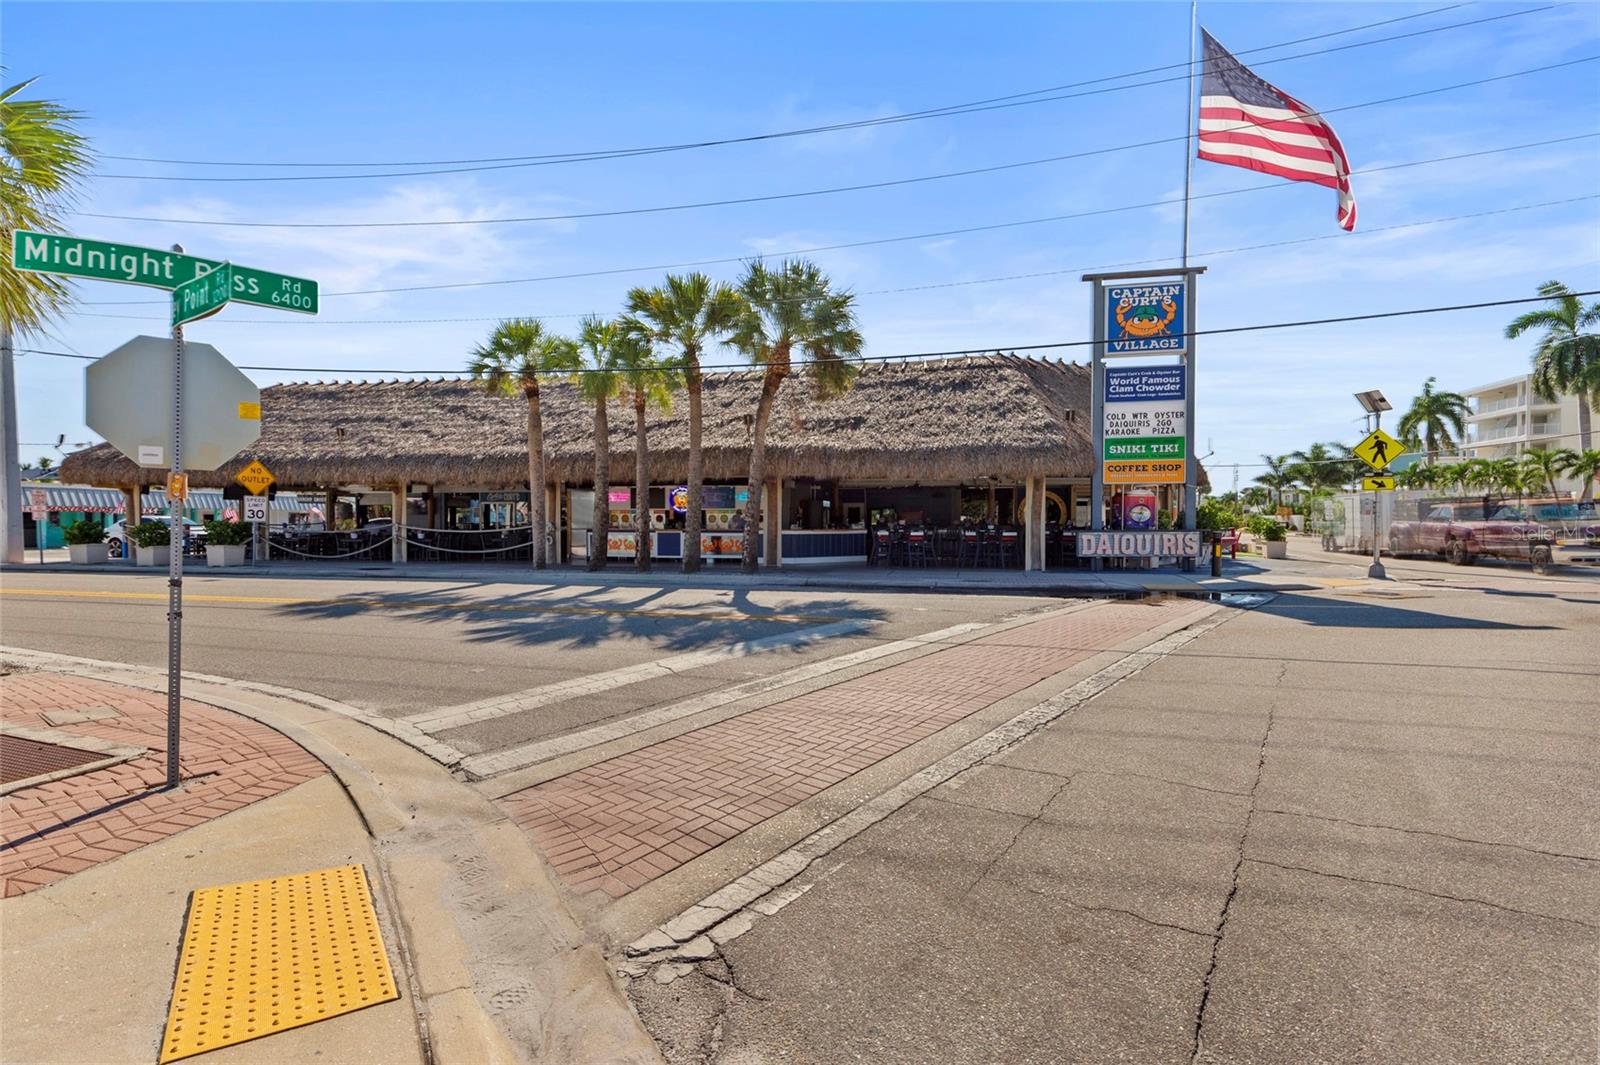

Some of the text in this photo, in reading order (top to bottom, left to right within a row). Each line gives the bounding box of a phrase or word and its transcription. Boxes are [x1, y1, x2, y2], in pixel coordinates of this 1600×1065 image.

[24, 236, 301, 295] Midnight Pss Rd
[184, 279, 209, 312] Point
[1112, 286, 1180, 298] CAPTAIN
[272, 291, 311, 308] 6400
[1120, 295, 1172, 306] CURT'S
[1113, 339, 1178, 351] VILLAGE
[1109, 376, 1180, 385] World Famous
[1109, 383, 1180, 393] Clam Chowder
[1106, 411, 1184, 421] COLD WTR OYSTER
[1109, 419, 1172, 428] DAIQUIRIS 2GO
[1105, 427, 1176, 436] KARAOKE PIZZA
[1109, 444, 1179, 454] SNIKI TIKI
[1107, 464, 1182, 472] COFFEE SHOP
[241, 475, 270, 484] OUTLET
[247, 509, 264, 519] 30
[1082, 533, 1199, 555] DAIQUIRIS
